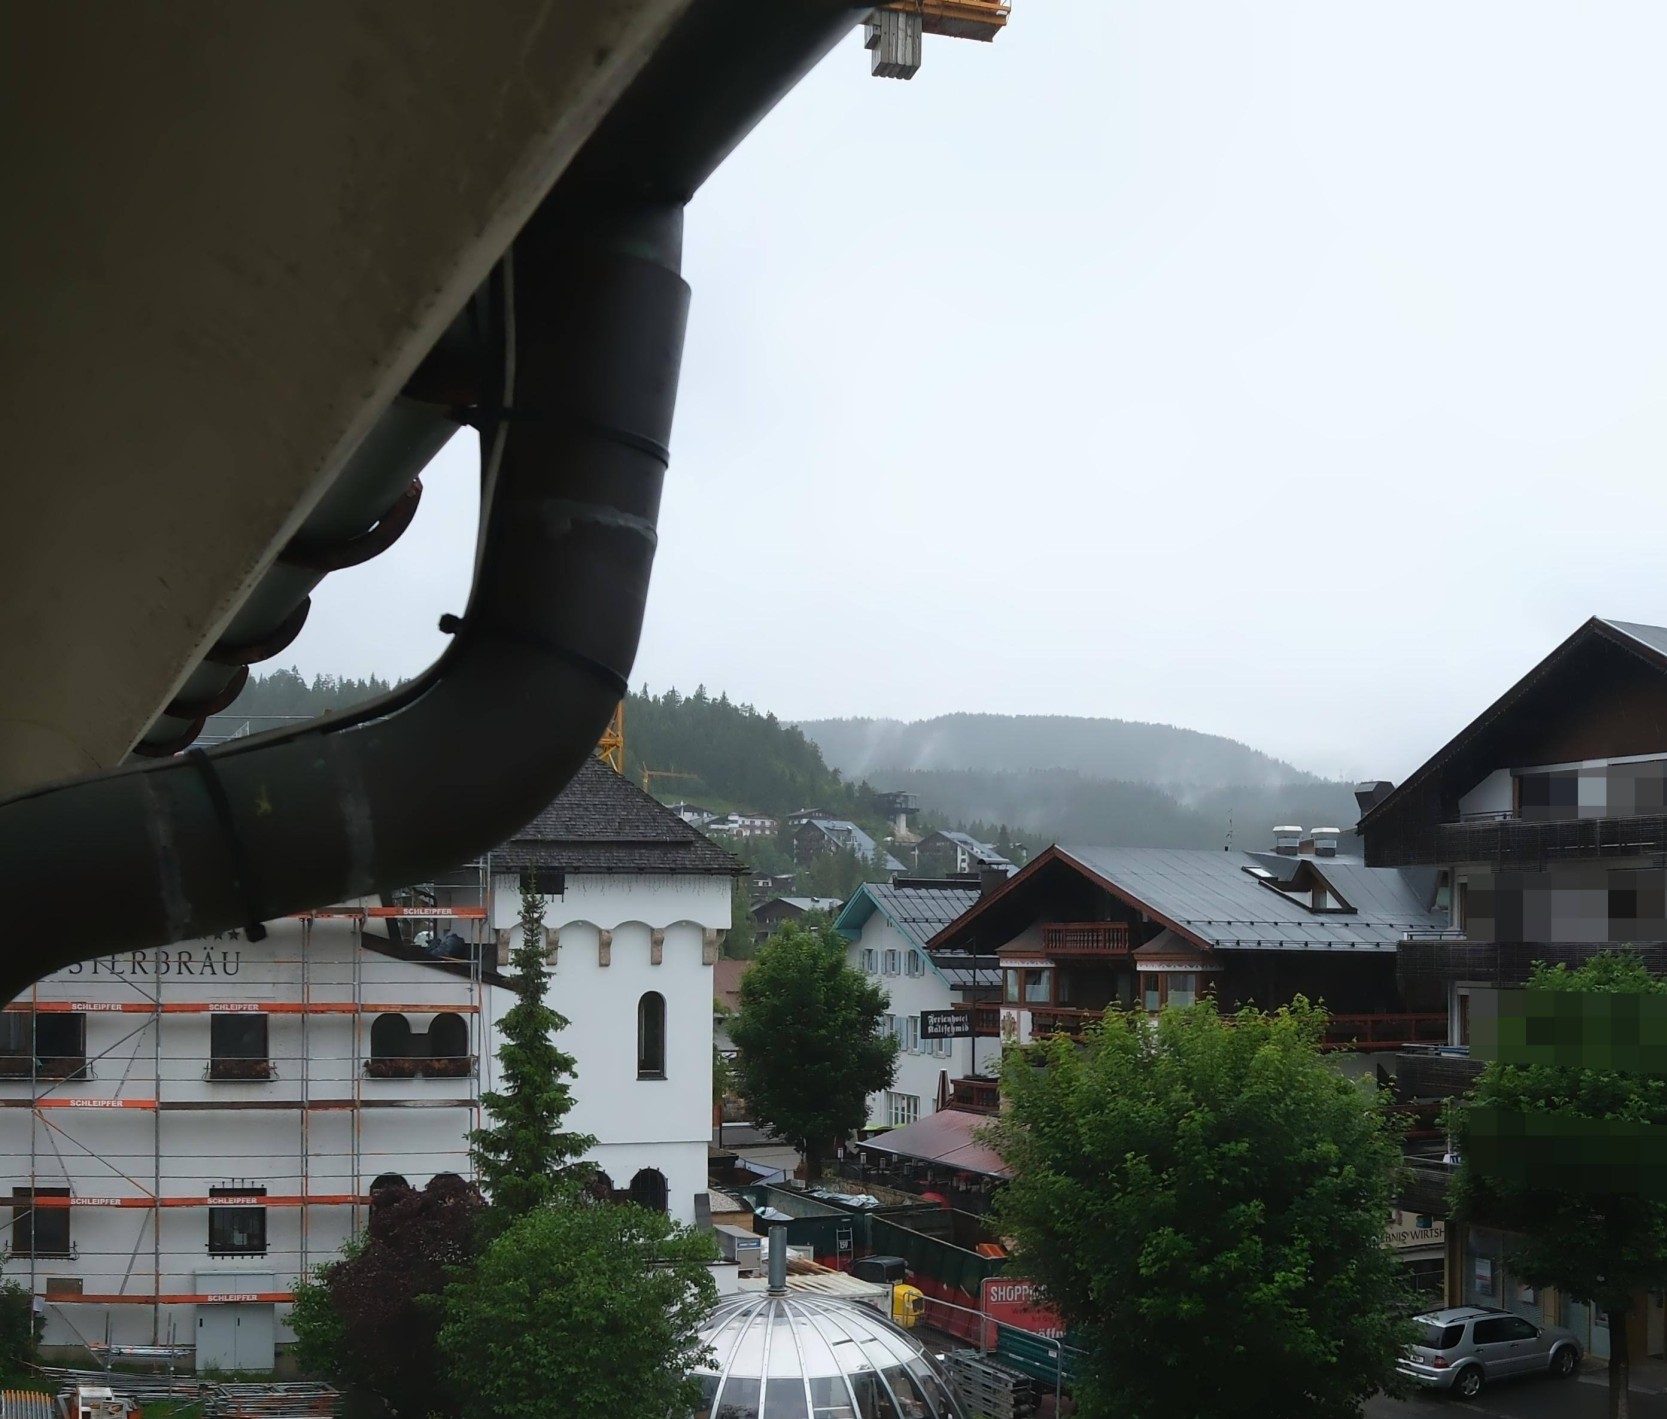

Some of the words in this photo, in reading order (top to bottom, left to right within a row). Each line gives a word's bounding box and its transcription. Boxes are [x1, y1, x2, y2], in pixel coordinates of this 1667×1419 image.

[403, 907, 452, 916] SCHLEIPFER
[54, 945, 241, 977] STERBRÄU
[71, 1003, 122, 1011] SCHLEIPFER
[208, 1003, 259, 1011] SCHLEIPFER
[70, 1198, 121, 1206] SCHLEIPFER
[207, 1197, 257, 1205] SCHLEIPFER
